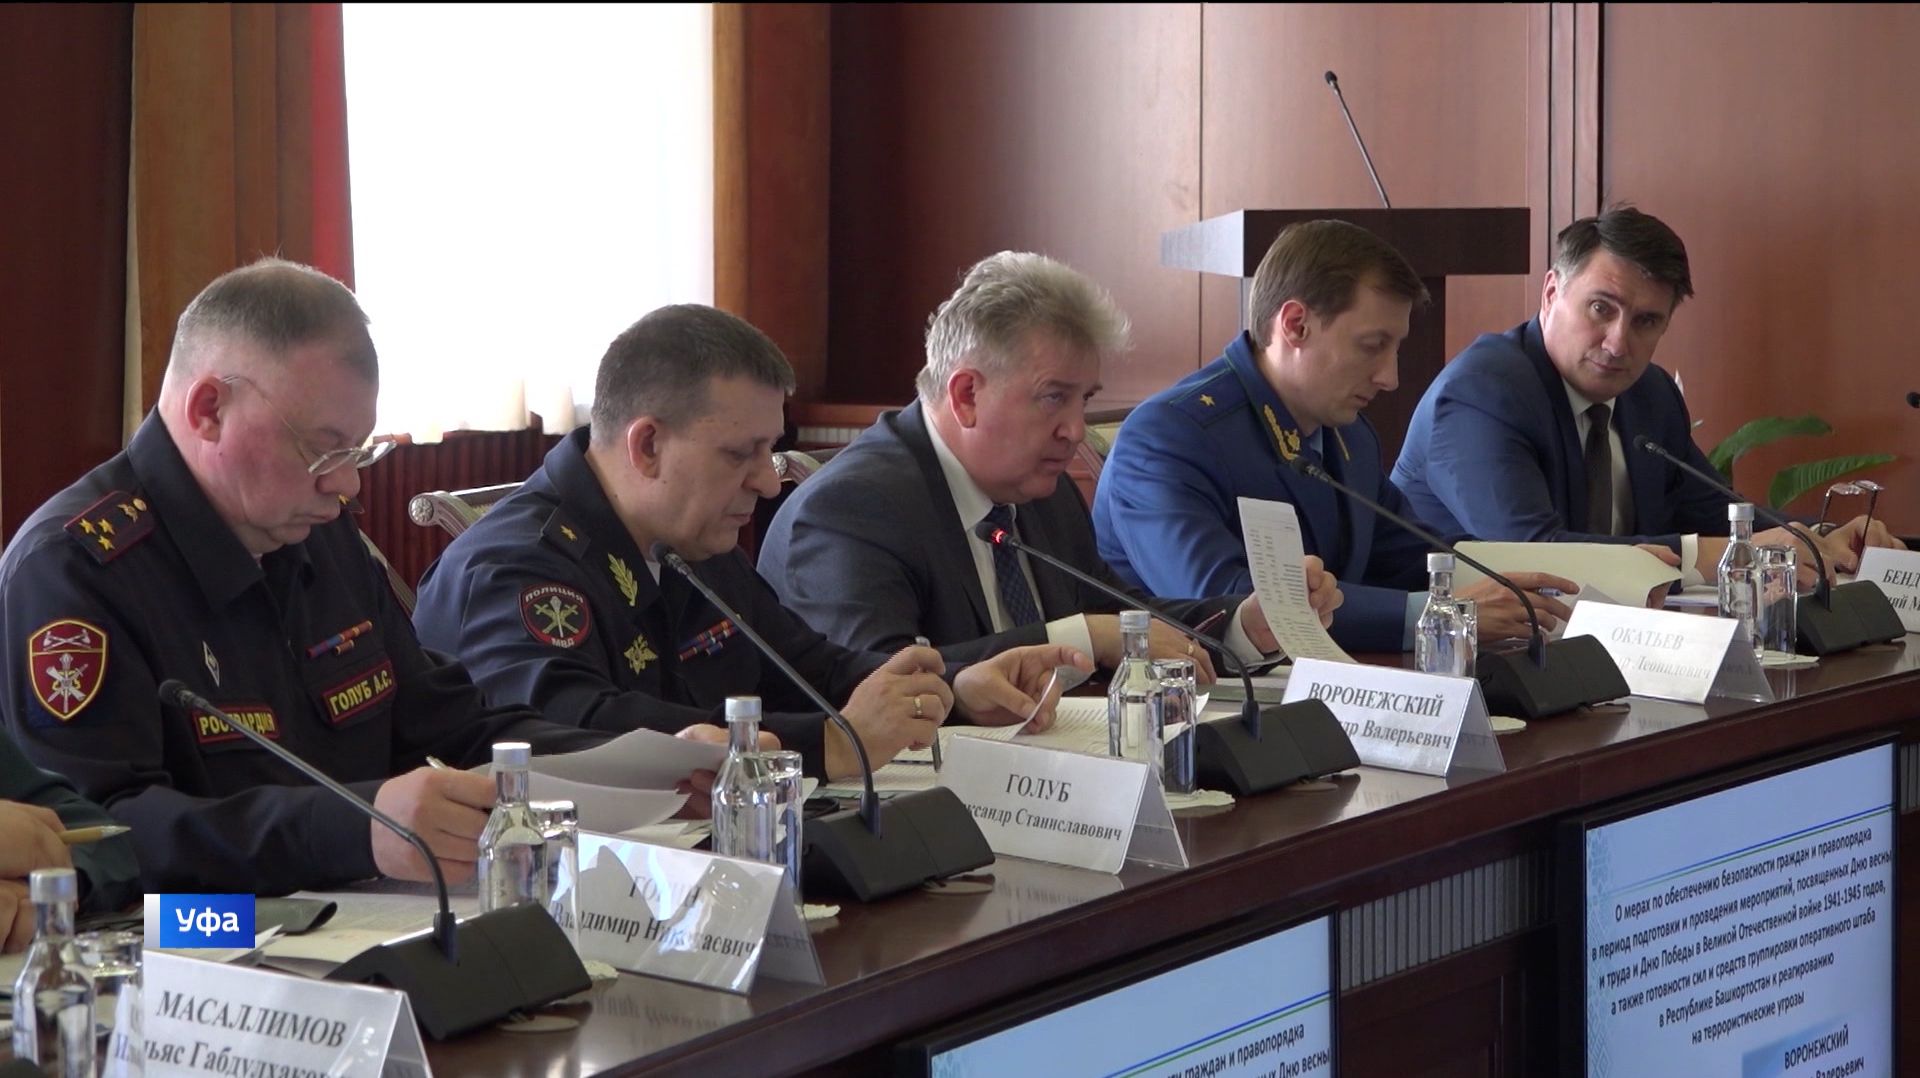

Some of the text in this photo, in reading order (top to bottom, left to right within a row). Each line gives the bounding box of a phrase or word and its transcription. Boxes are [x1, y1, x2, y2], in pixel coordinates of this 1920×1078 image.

[525, 586, 584, 604] ПОЛИЦИЯ
[550, 637, 575, 648] МВД
[1612, 626, 1684, 650] ОКАТЬЕВ
[329, 670, 392, 715] ГОЛУБ А.С.
[1308, 682, 1444, 717] ВОРОНЕЖСКИЙ
[1361, 720, 1452, 749] Валерьевич
[1005, 774, 1072, 803] ГОЛУБ
[963, 803, 1122, 841] ксандр Станиславович
[1616, 828, 1872, 922] О мерах по обеспечению безопасности граждан и правопорядка
[1592, 850, 1892, 961] в период подготовки и проведения мероприятий, посвященных Дню весны
[1600, 880, 1886, 990] и труда и Дню Победы в Великой Отечественной войне 1941-1945 годов,
[1611, 906, 1876, 1016] а также готовности сил и средств группировки оперативного штаба
[1660, 952, 1834, 1028] в Республике Башкортостан к реагированию
[156, 991, 348, 1048] МАСАЛЛИМОВ
[1692, 991, 1804, 1045] на террористические угрозы
[1185, 1024, 1304, 1078] граждан и правопорядка
[1280, 1048, 1330, 1078] Дню весны
[1784, 1024, 1849, 1070] ВОРОНЕЖСКИЙ
